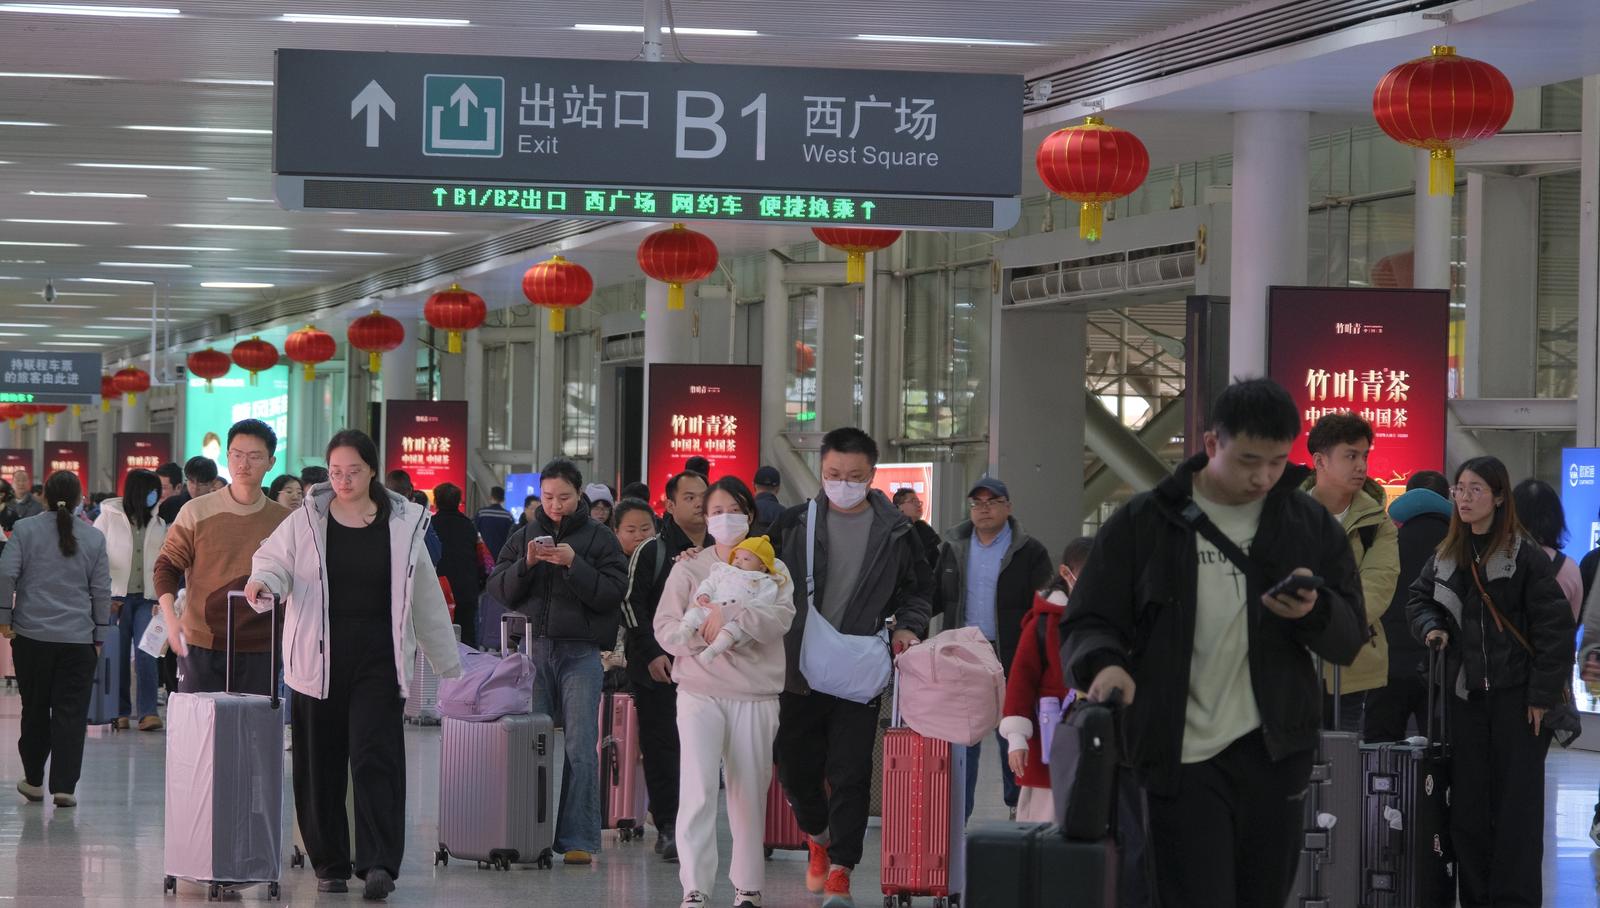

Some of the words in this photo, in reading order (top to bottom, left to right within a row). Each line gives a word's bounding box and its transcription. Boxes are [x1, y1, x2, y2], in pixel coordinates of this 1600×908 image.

[519, 83, 649, 129] 出站口
[803, 94, 938, 141] 西广场
[675, 90, 767, 161] B1
[518, 134, 559, 154] Exit
[803, 143, 857, 163] West
[862, 145, 939, 169] Square
[453, 188, 567, 211] B1/B2出口
[584, 190, 656, 213] 西广场
[671, 193, 743, 215] 网约车
[759, 195, 855, 219] 便捷换乘
[1335, 322, 1361, 335] 竹叶青
[11, 358, 73, 372] 持联程车票
[4, 371, 79, 385] 的旅客由此进
[1305, 367, 1411, 403] 竹叶青茶
[671, 414, 738, 437] 竹叶青茶
[1360, 407, 1408, 428] 中国茶
[671, 438, 702, 452] 中国礼
[705, 438, 737, 452] 中国茶
